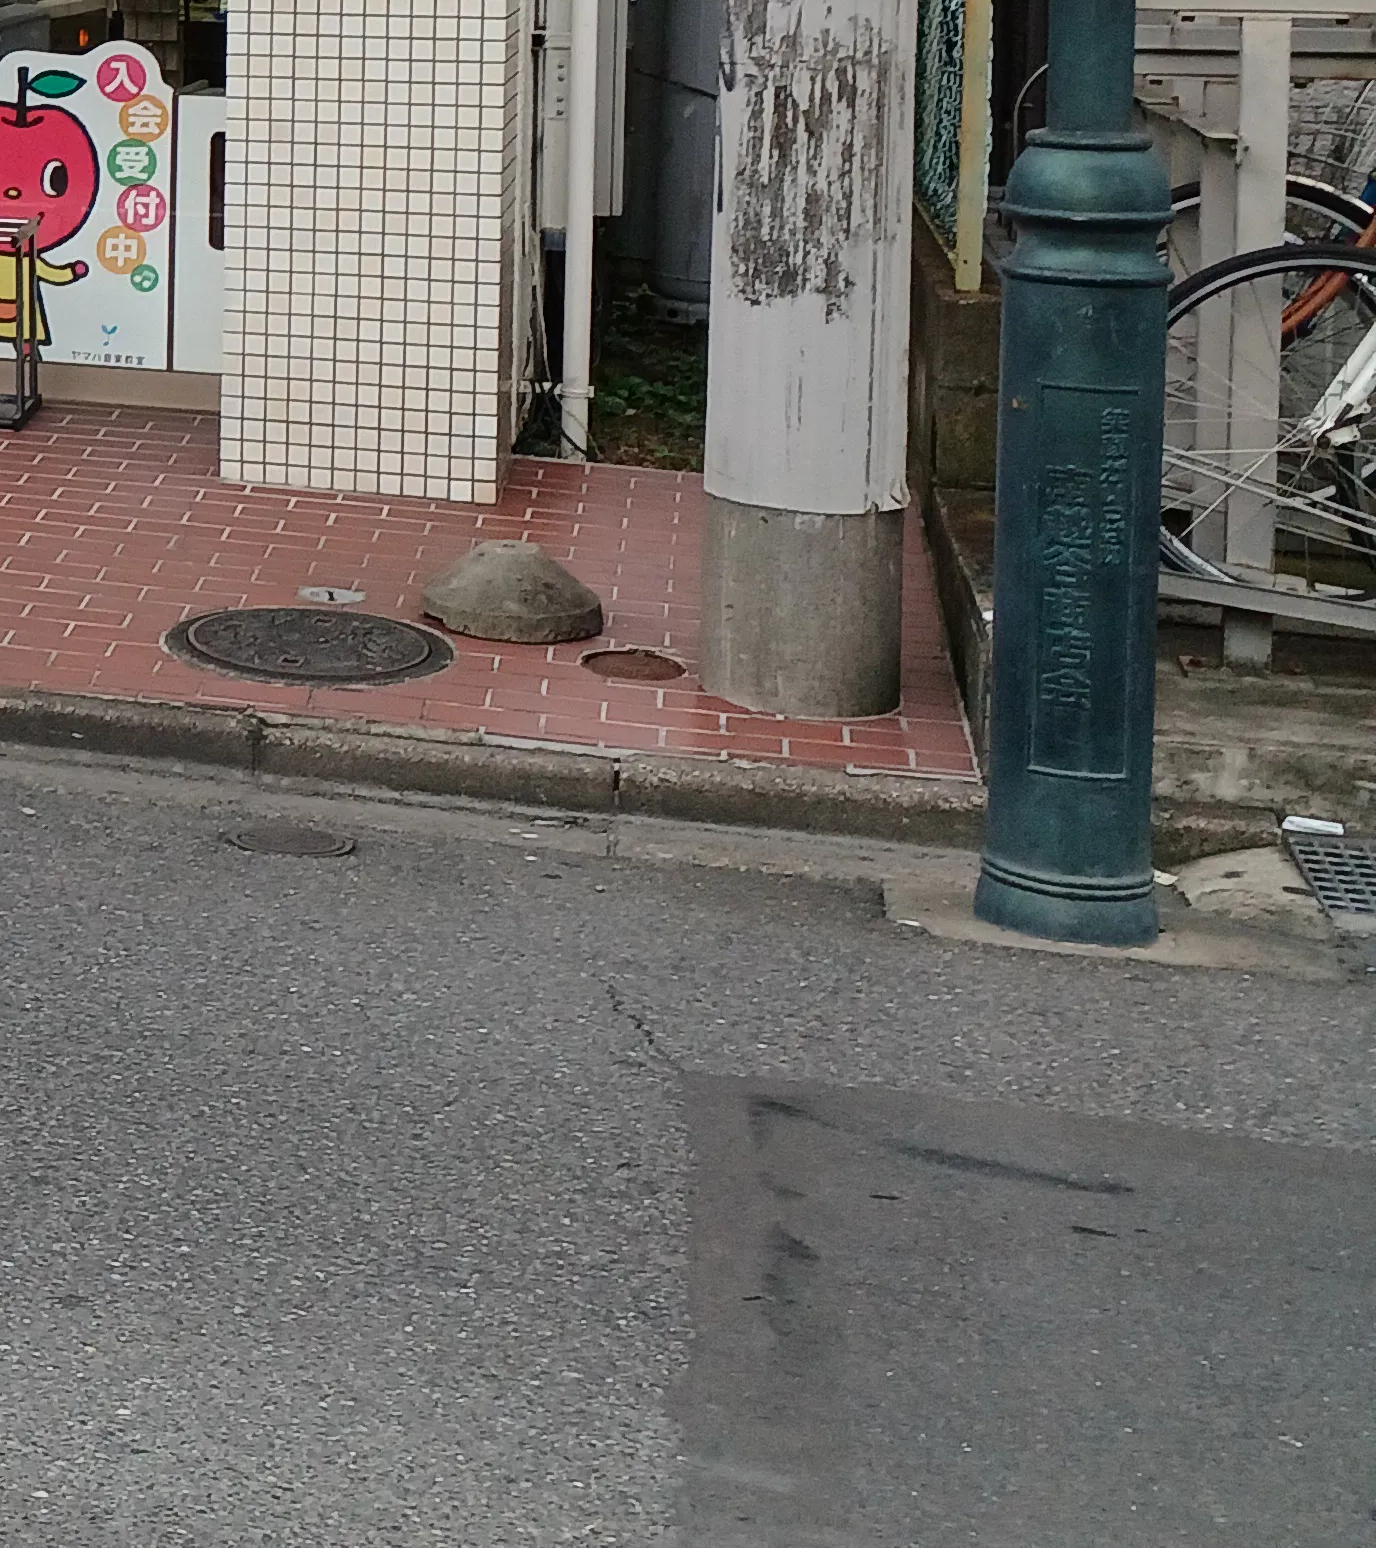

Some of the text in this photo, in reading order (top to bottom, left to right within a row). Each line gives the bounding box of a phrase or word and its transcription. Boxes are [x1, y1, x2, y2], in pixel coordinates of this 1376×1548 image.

[103, 60, 161, 268] 入会受付中
